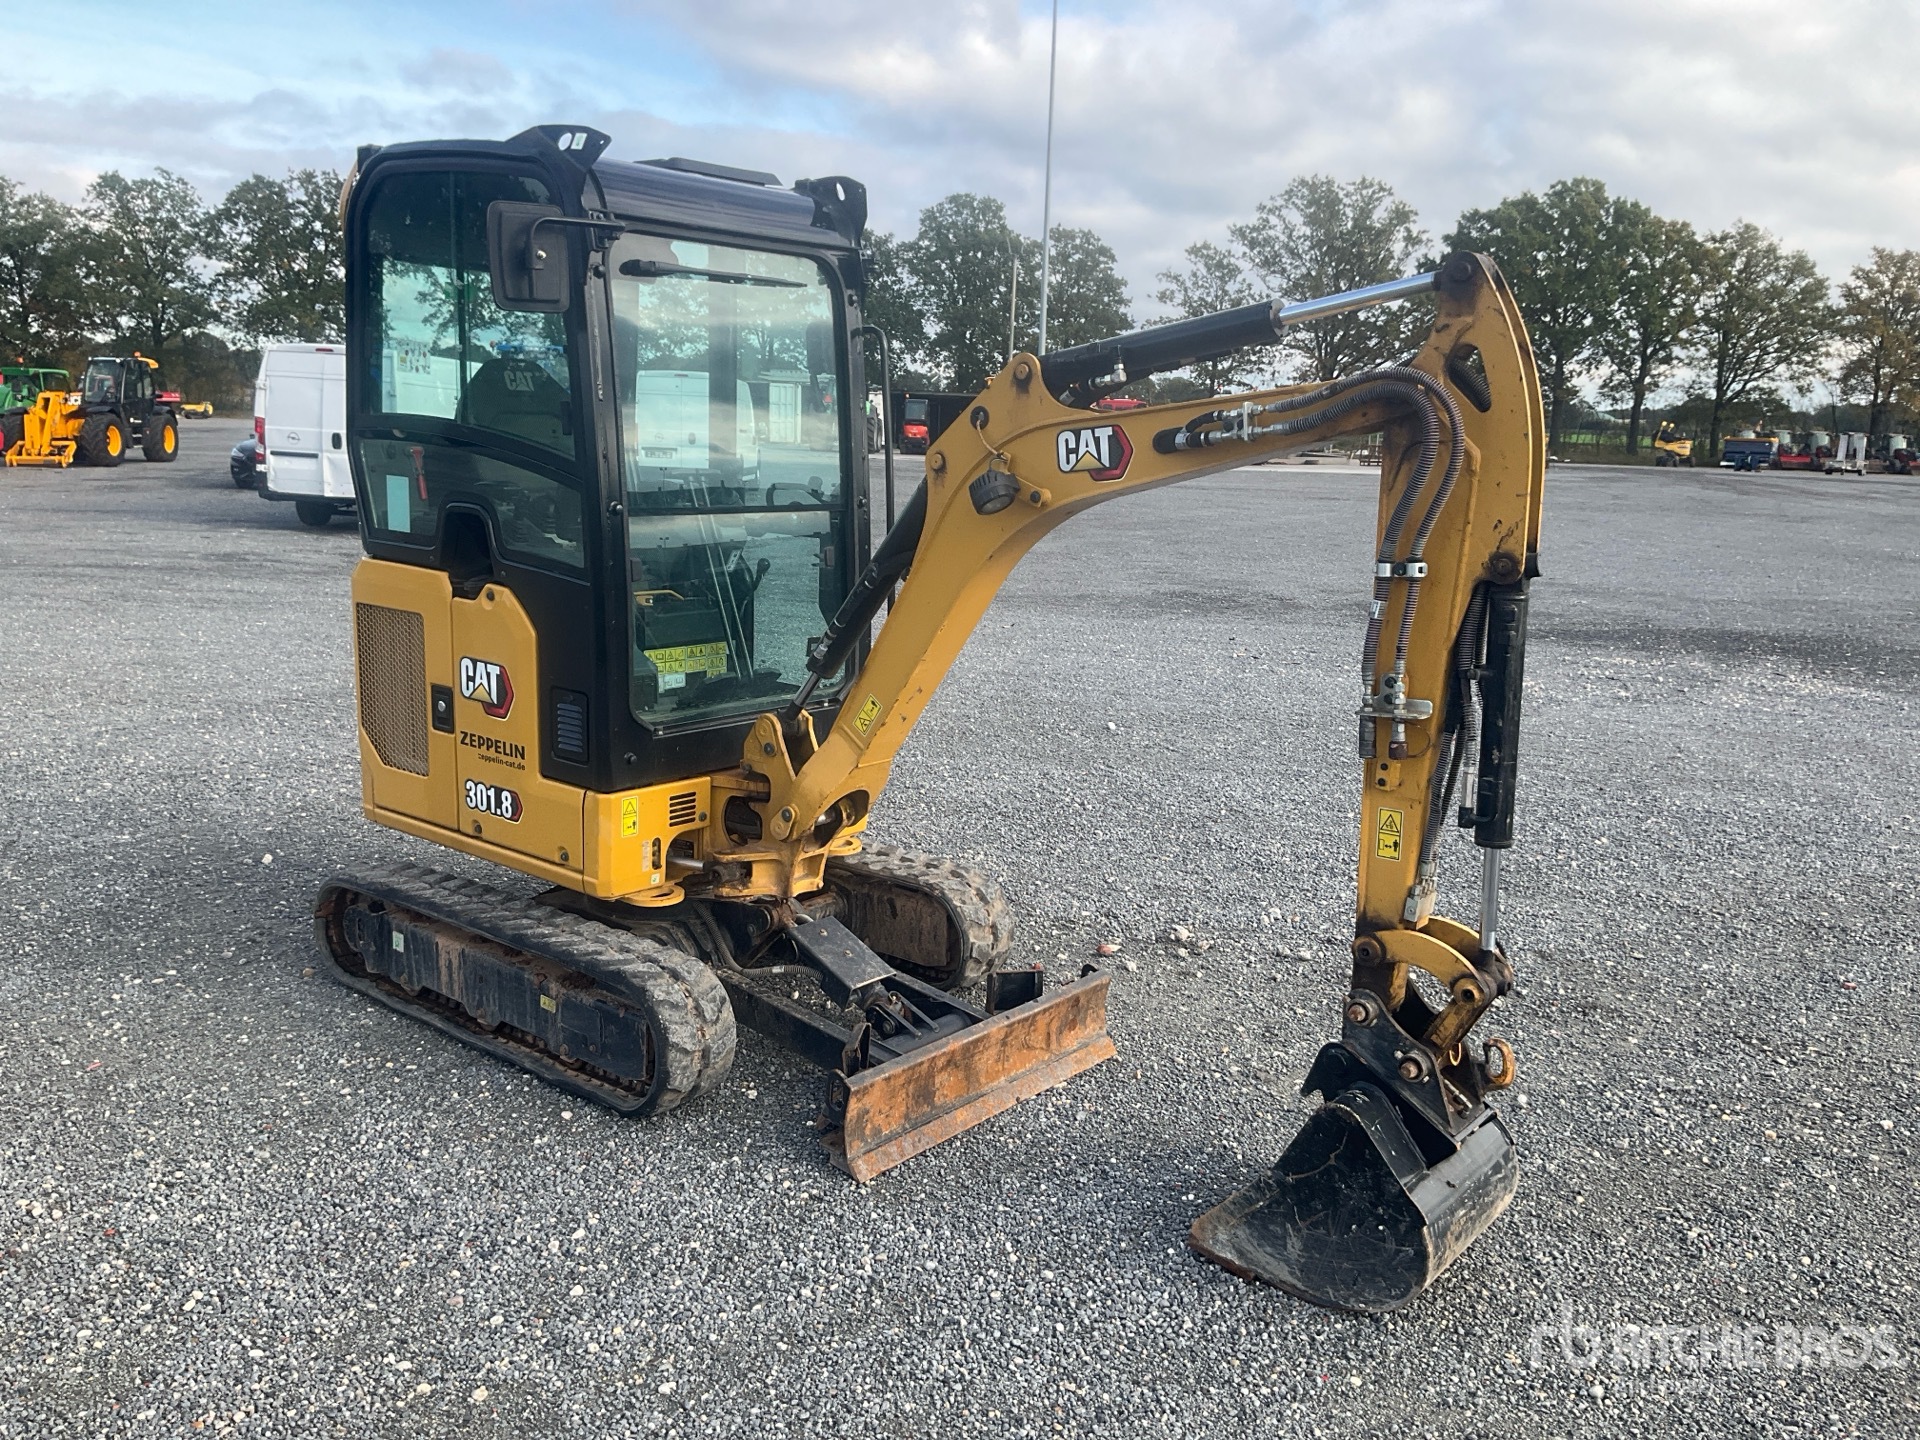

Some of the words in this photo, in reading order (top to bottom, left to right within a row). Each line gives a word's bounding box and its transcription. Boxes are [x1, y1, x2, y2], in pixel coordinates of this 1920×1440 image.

[503, 370, 535, 392] CAT
[1057, 426, 1113, 472] CAT
[460, 657, 499, 705] CAT
[460, 730, 525, 760] ZEPPELIN
[465, 779, 512, 819] 301.8
